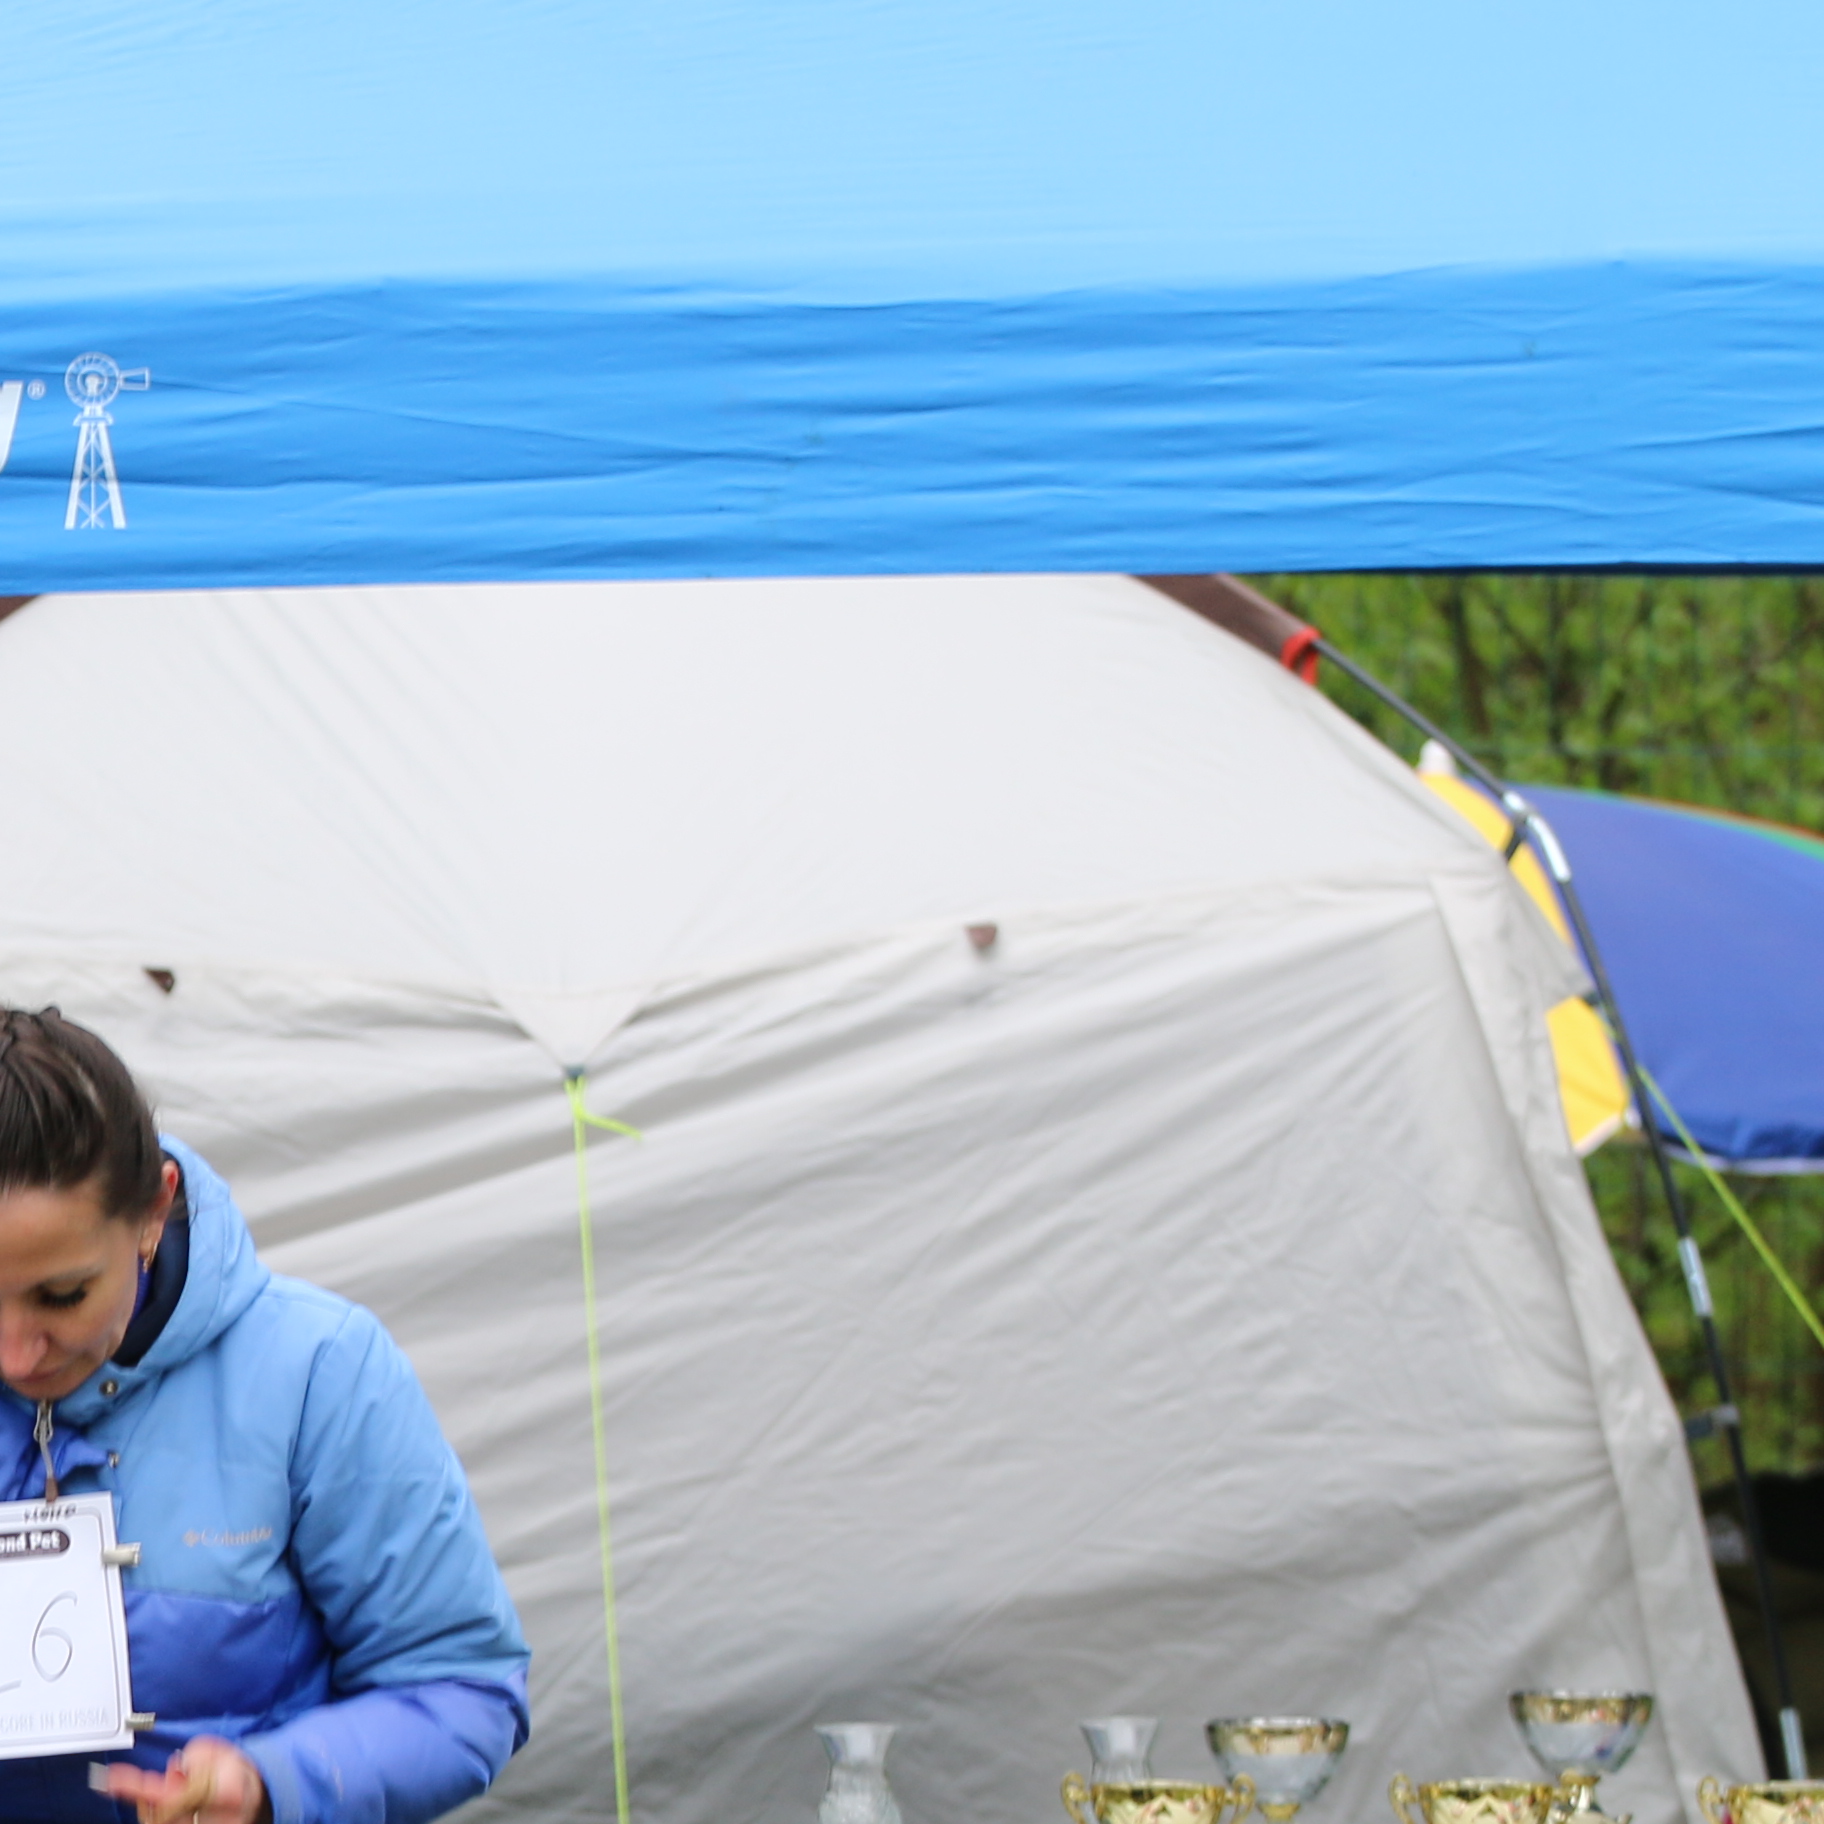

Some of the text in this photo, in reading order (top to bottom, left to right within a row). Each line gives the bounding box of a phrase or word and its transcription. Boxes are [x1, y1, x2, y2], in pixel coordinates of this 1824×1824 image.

[29, 1531, 61, 1551] Pet
[37, 1713, 54, 1731] IN
[57, 1707, 109, 1730] RUSSIA
